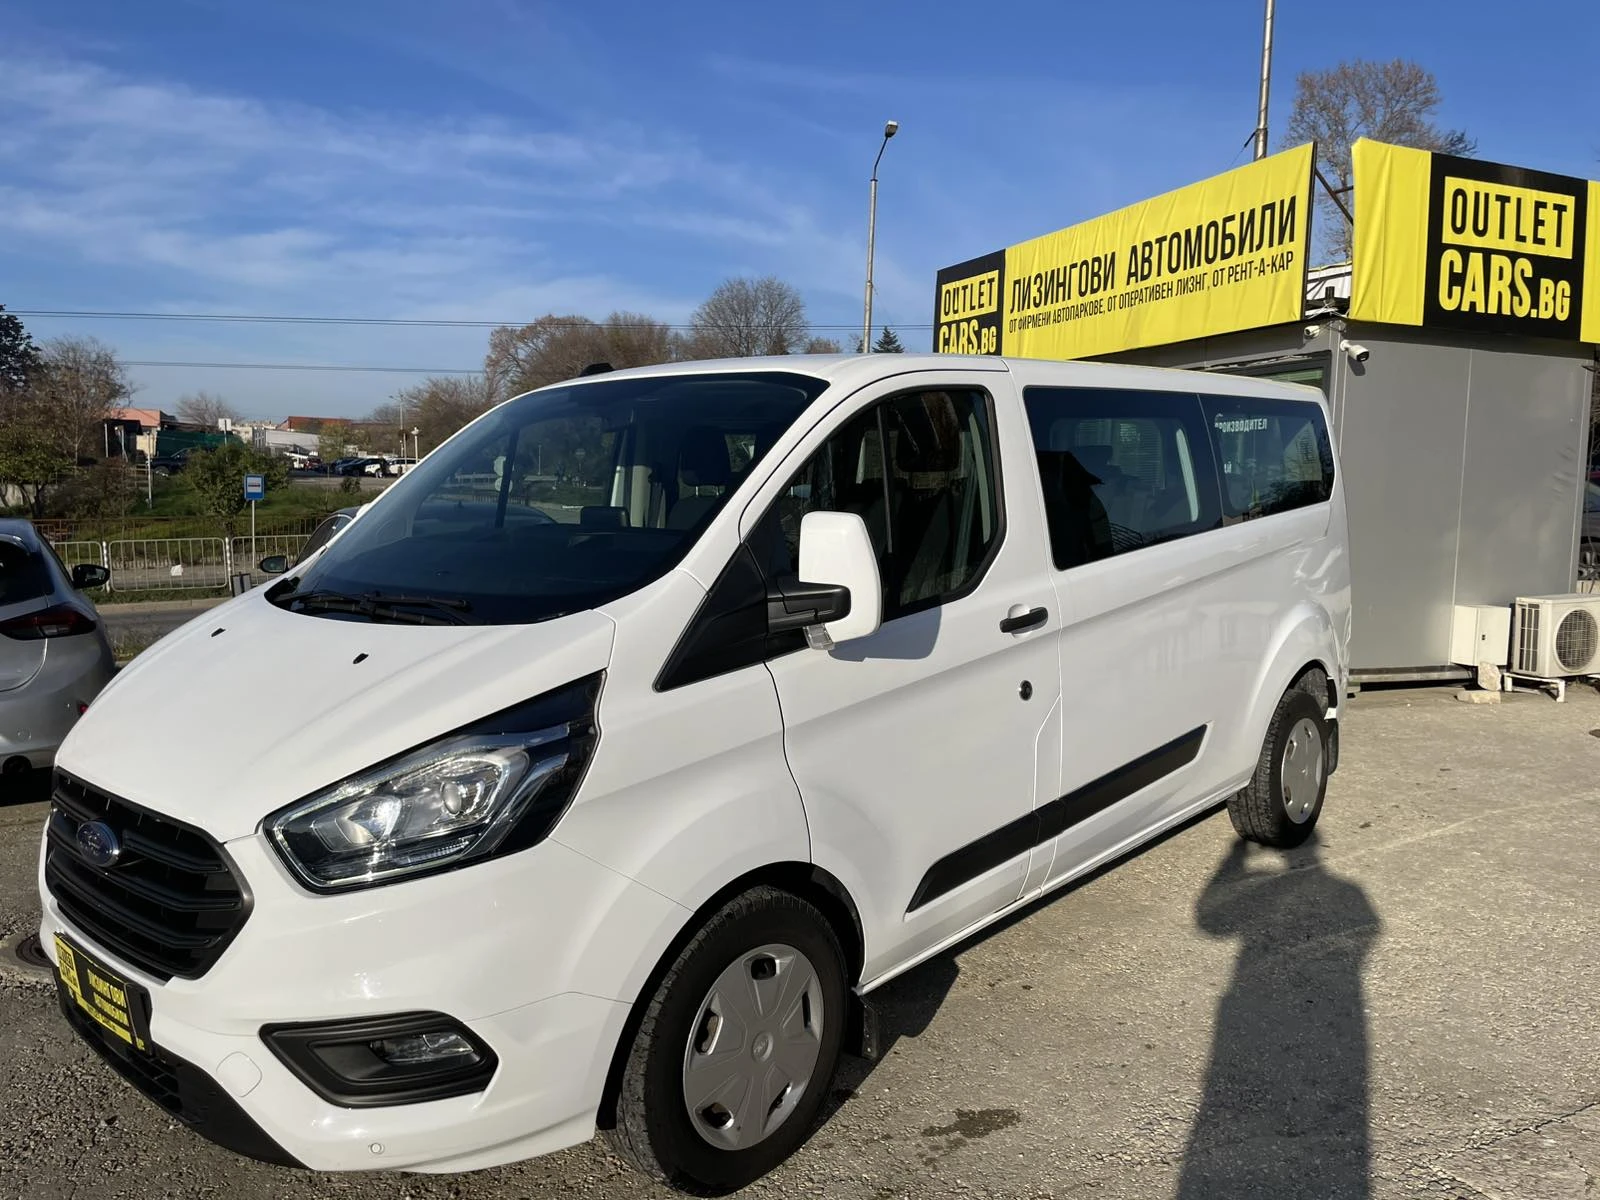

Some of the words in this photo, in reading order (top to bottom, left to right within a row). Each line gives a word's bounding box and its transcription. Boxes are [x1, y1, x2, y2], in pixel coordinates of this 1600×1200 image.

[1451, 188, 1567, 248] OUTLET
[1010, 251, 1116, 314] ЛИЗИНГОВИ
[1126, 195, 1297, 286] АВТОМОБИЛИ
[1438, 249, 1571, 322] CARS.BG
[943, 277, 996, 317] OUTLET
[1009, 318, 1018, 334] ОТ
[1018, 310, 1051, 330] ФИРМЕНИ
[1052, 298, 1106, 324] АВТОПАРКОВЕ,
[1107, 294, 1118, 312] ОТ
[1119, 282, 1173, 310] ОПЕРАТИВЕН
[1212, 267, 1226, 288] ОТ
[1227, 250, 1294, 285] РЕНТ-А-КАР
[939, 319, 997, 355] CARS.BG
